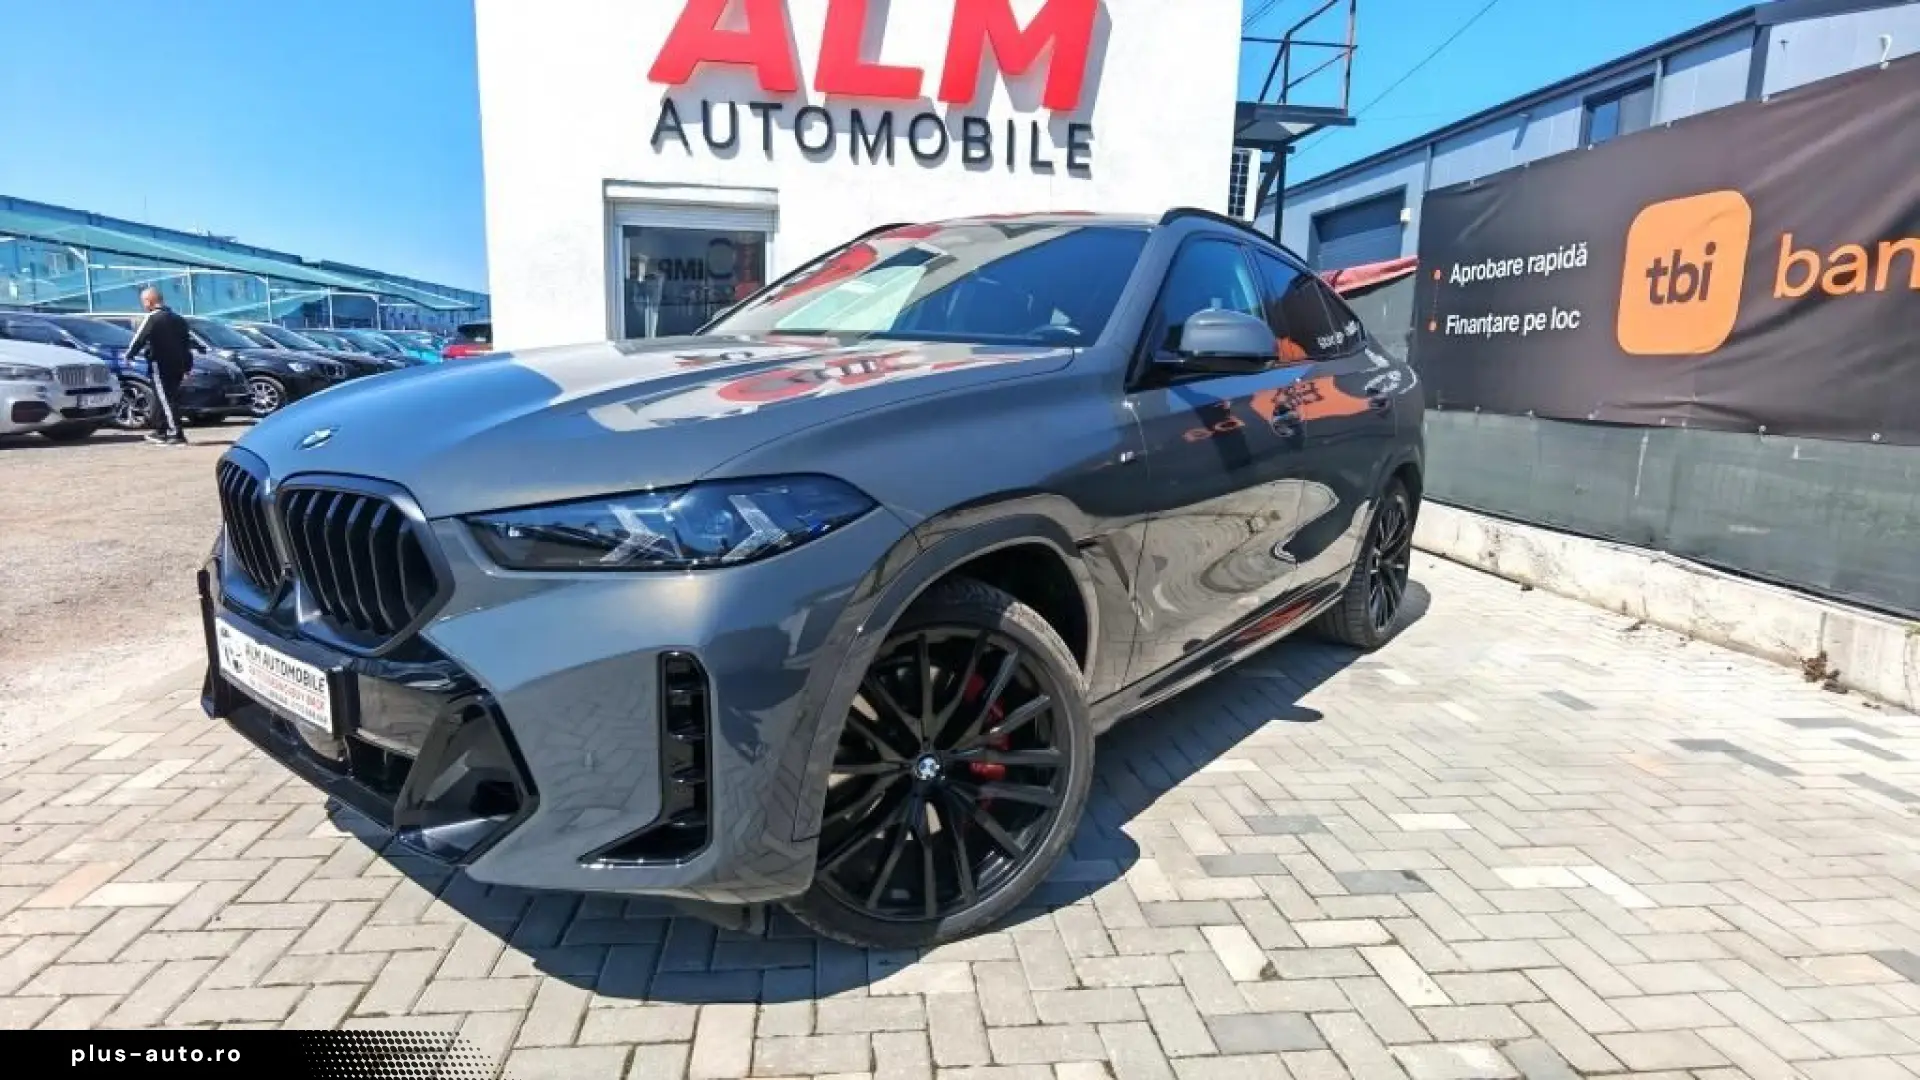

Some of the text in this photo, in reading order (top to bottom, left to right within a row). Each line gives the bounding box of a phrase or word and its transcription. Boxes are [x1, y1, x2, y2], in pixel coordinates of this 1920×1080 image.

[647, 0, 1097, 111] ALM
[650, 98, 1093, 174] AUTOMOBILE
[1449, 241, 1588, 286] Aprobare rapidă
[1646, 241, 1717, 305] tbi
[1445, 306, 1580, 338] Finanțare pe loc
[262, 651, 325, 693] AUTOMOBILE
